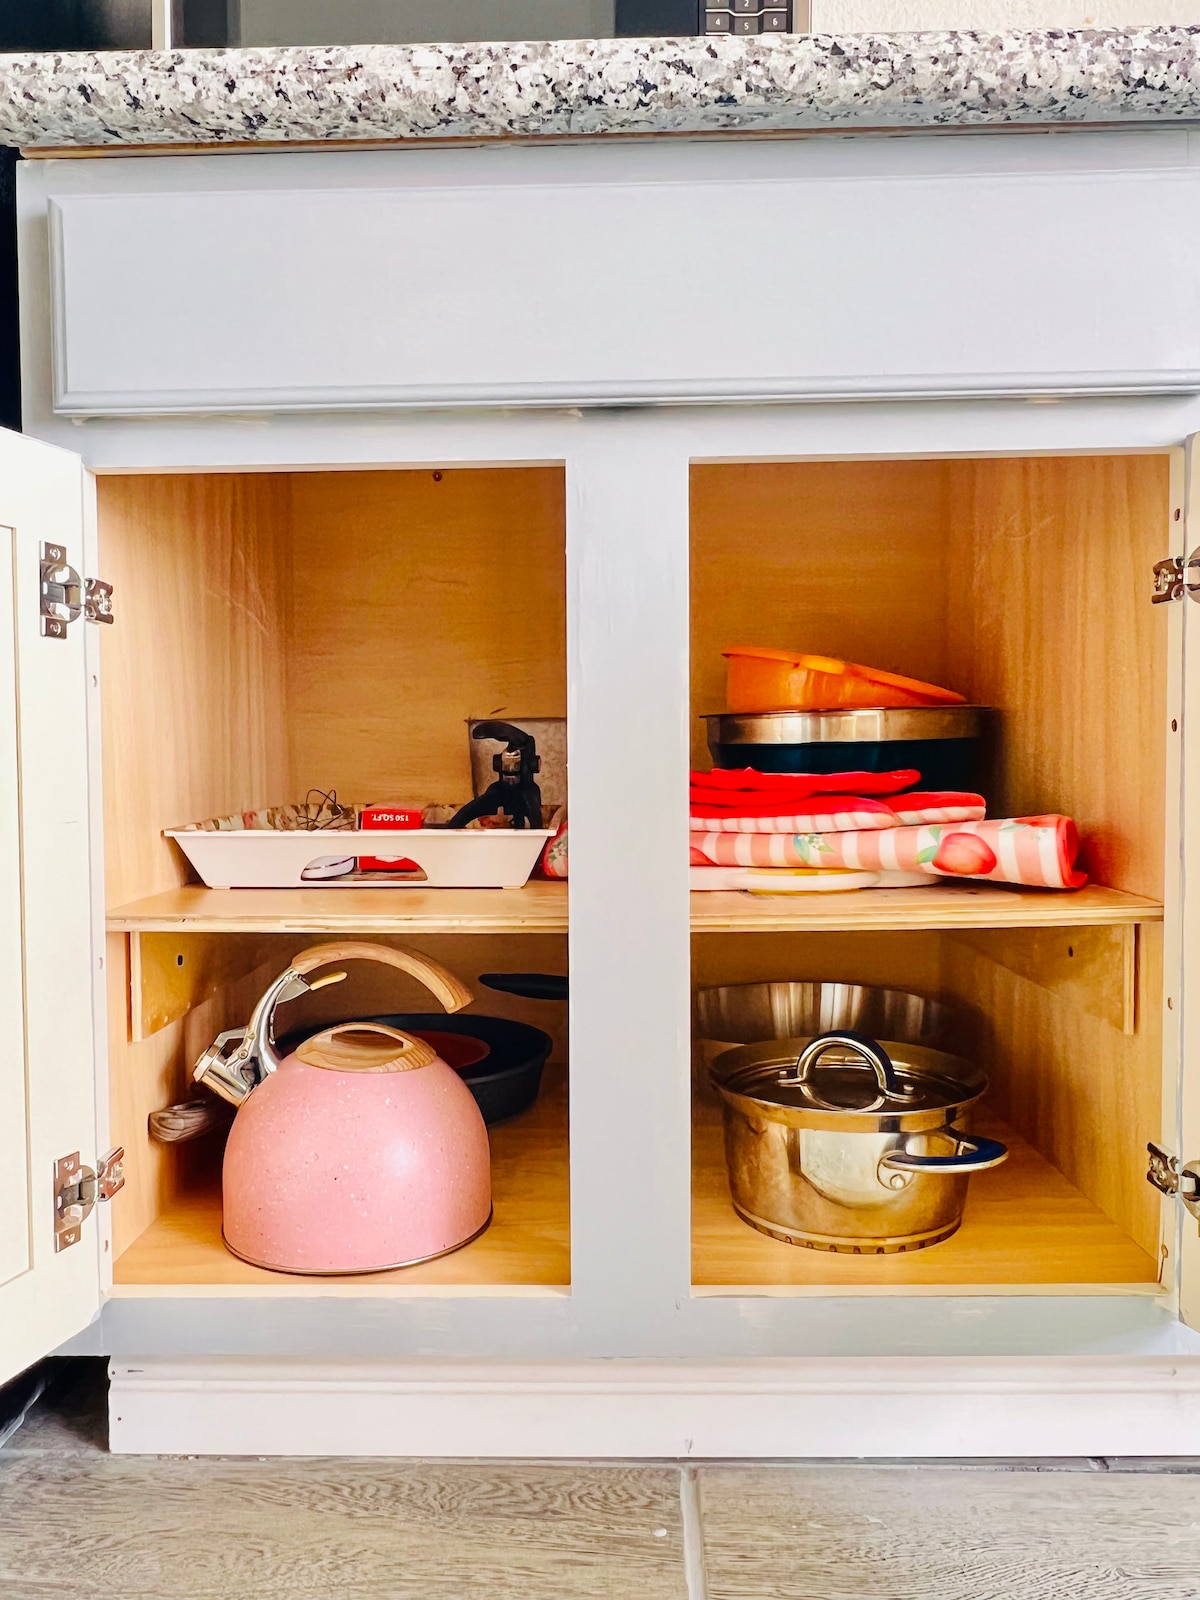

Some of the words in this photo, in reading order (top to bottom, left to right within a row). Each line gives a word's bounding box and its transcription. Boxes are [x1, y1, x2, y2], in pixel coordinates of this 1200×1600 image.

[715, 18, 721, 26] 4
[772, 17, 778, 26] 6
[744, 22, 749, 30] 5
[395, 813, 409, 822] 150
